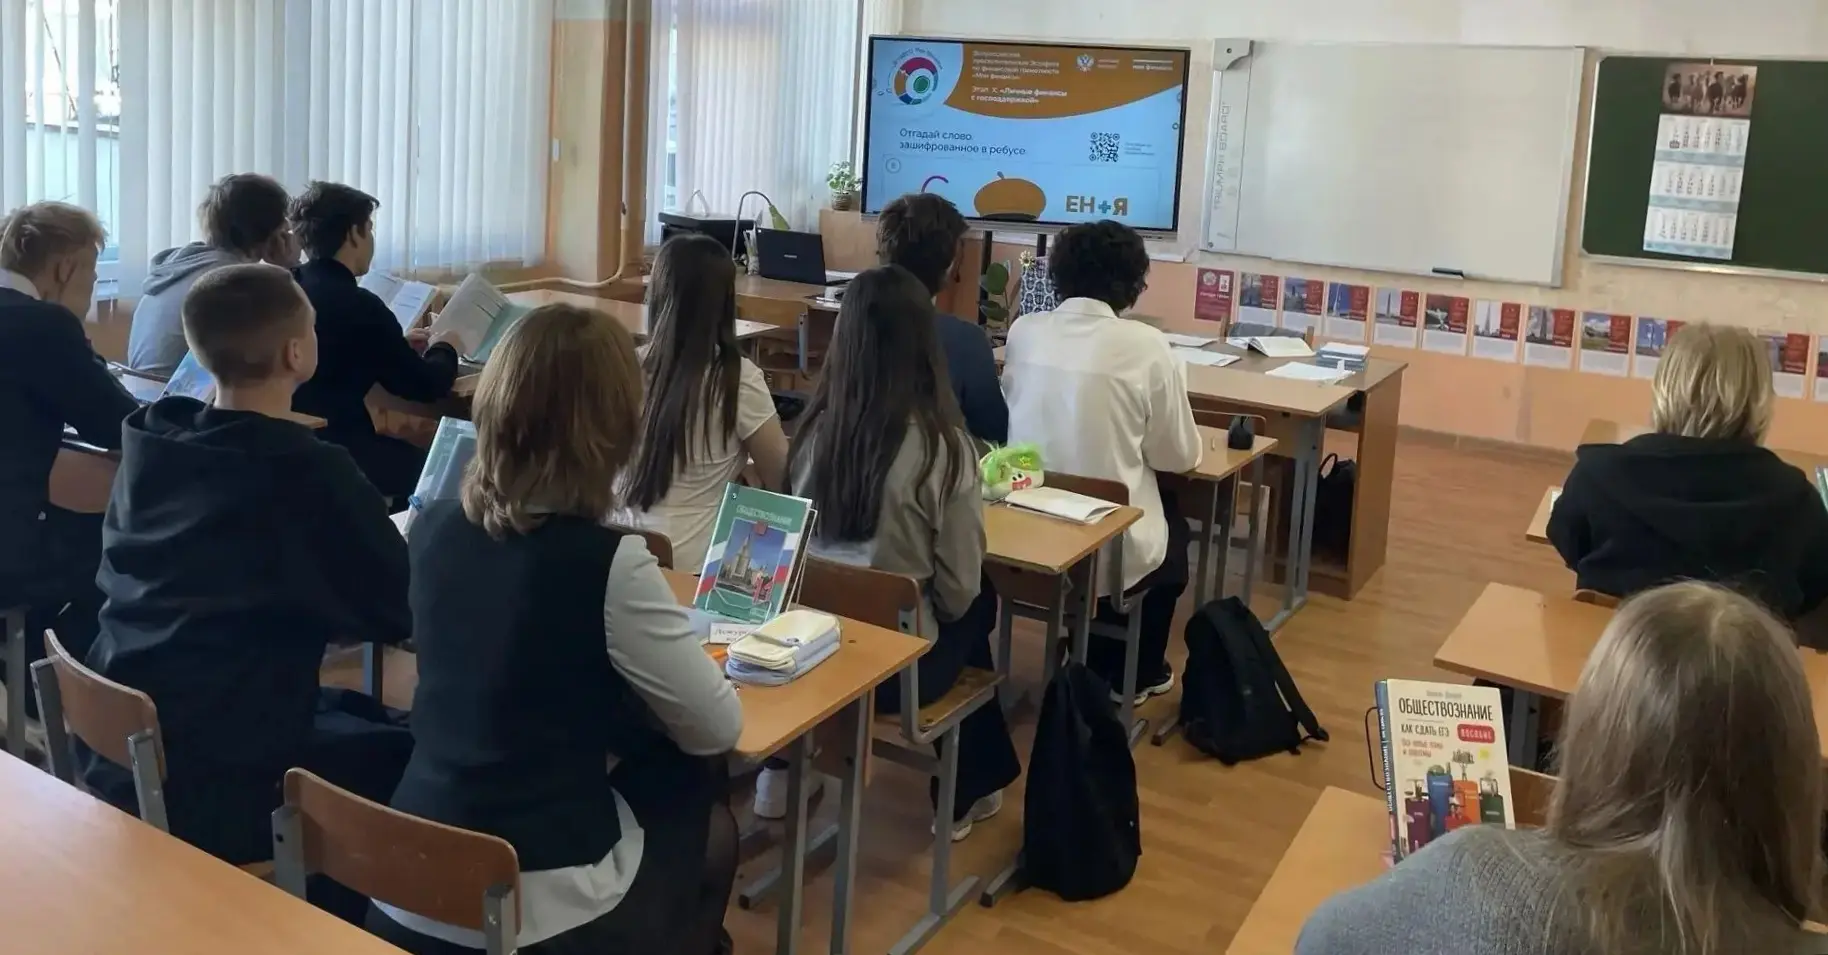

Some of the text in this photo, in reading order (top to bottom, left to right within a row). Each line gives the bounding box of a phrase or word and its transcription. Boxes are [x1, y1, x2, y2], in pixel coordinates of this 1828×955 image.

[899, 127, 940, 139] Отгадай
[899, 141, 979, 153] зашифрованное
[989, 145, 1026, 156] ребусе
[1398, 697, 1494, 721] ОБЩЕСТВОЗНАНИЕ
[1400, 723, 1450, 737] КАК СДАТЬ ЕГЭ
